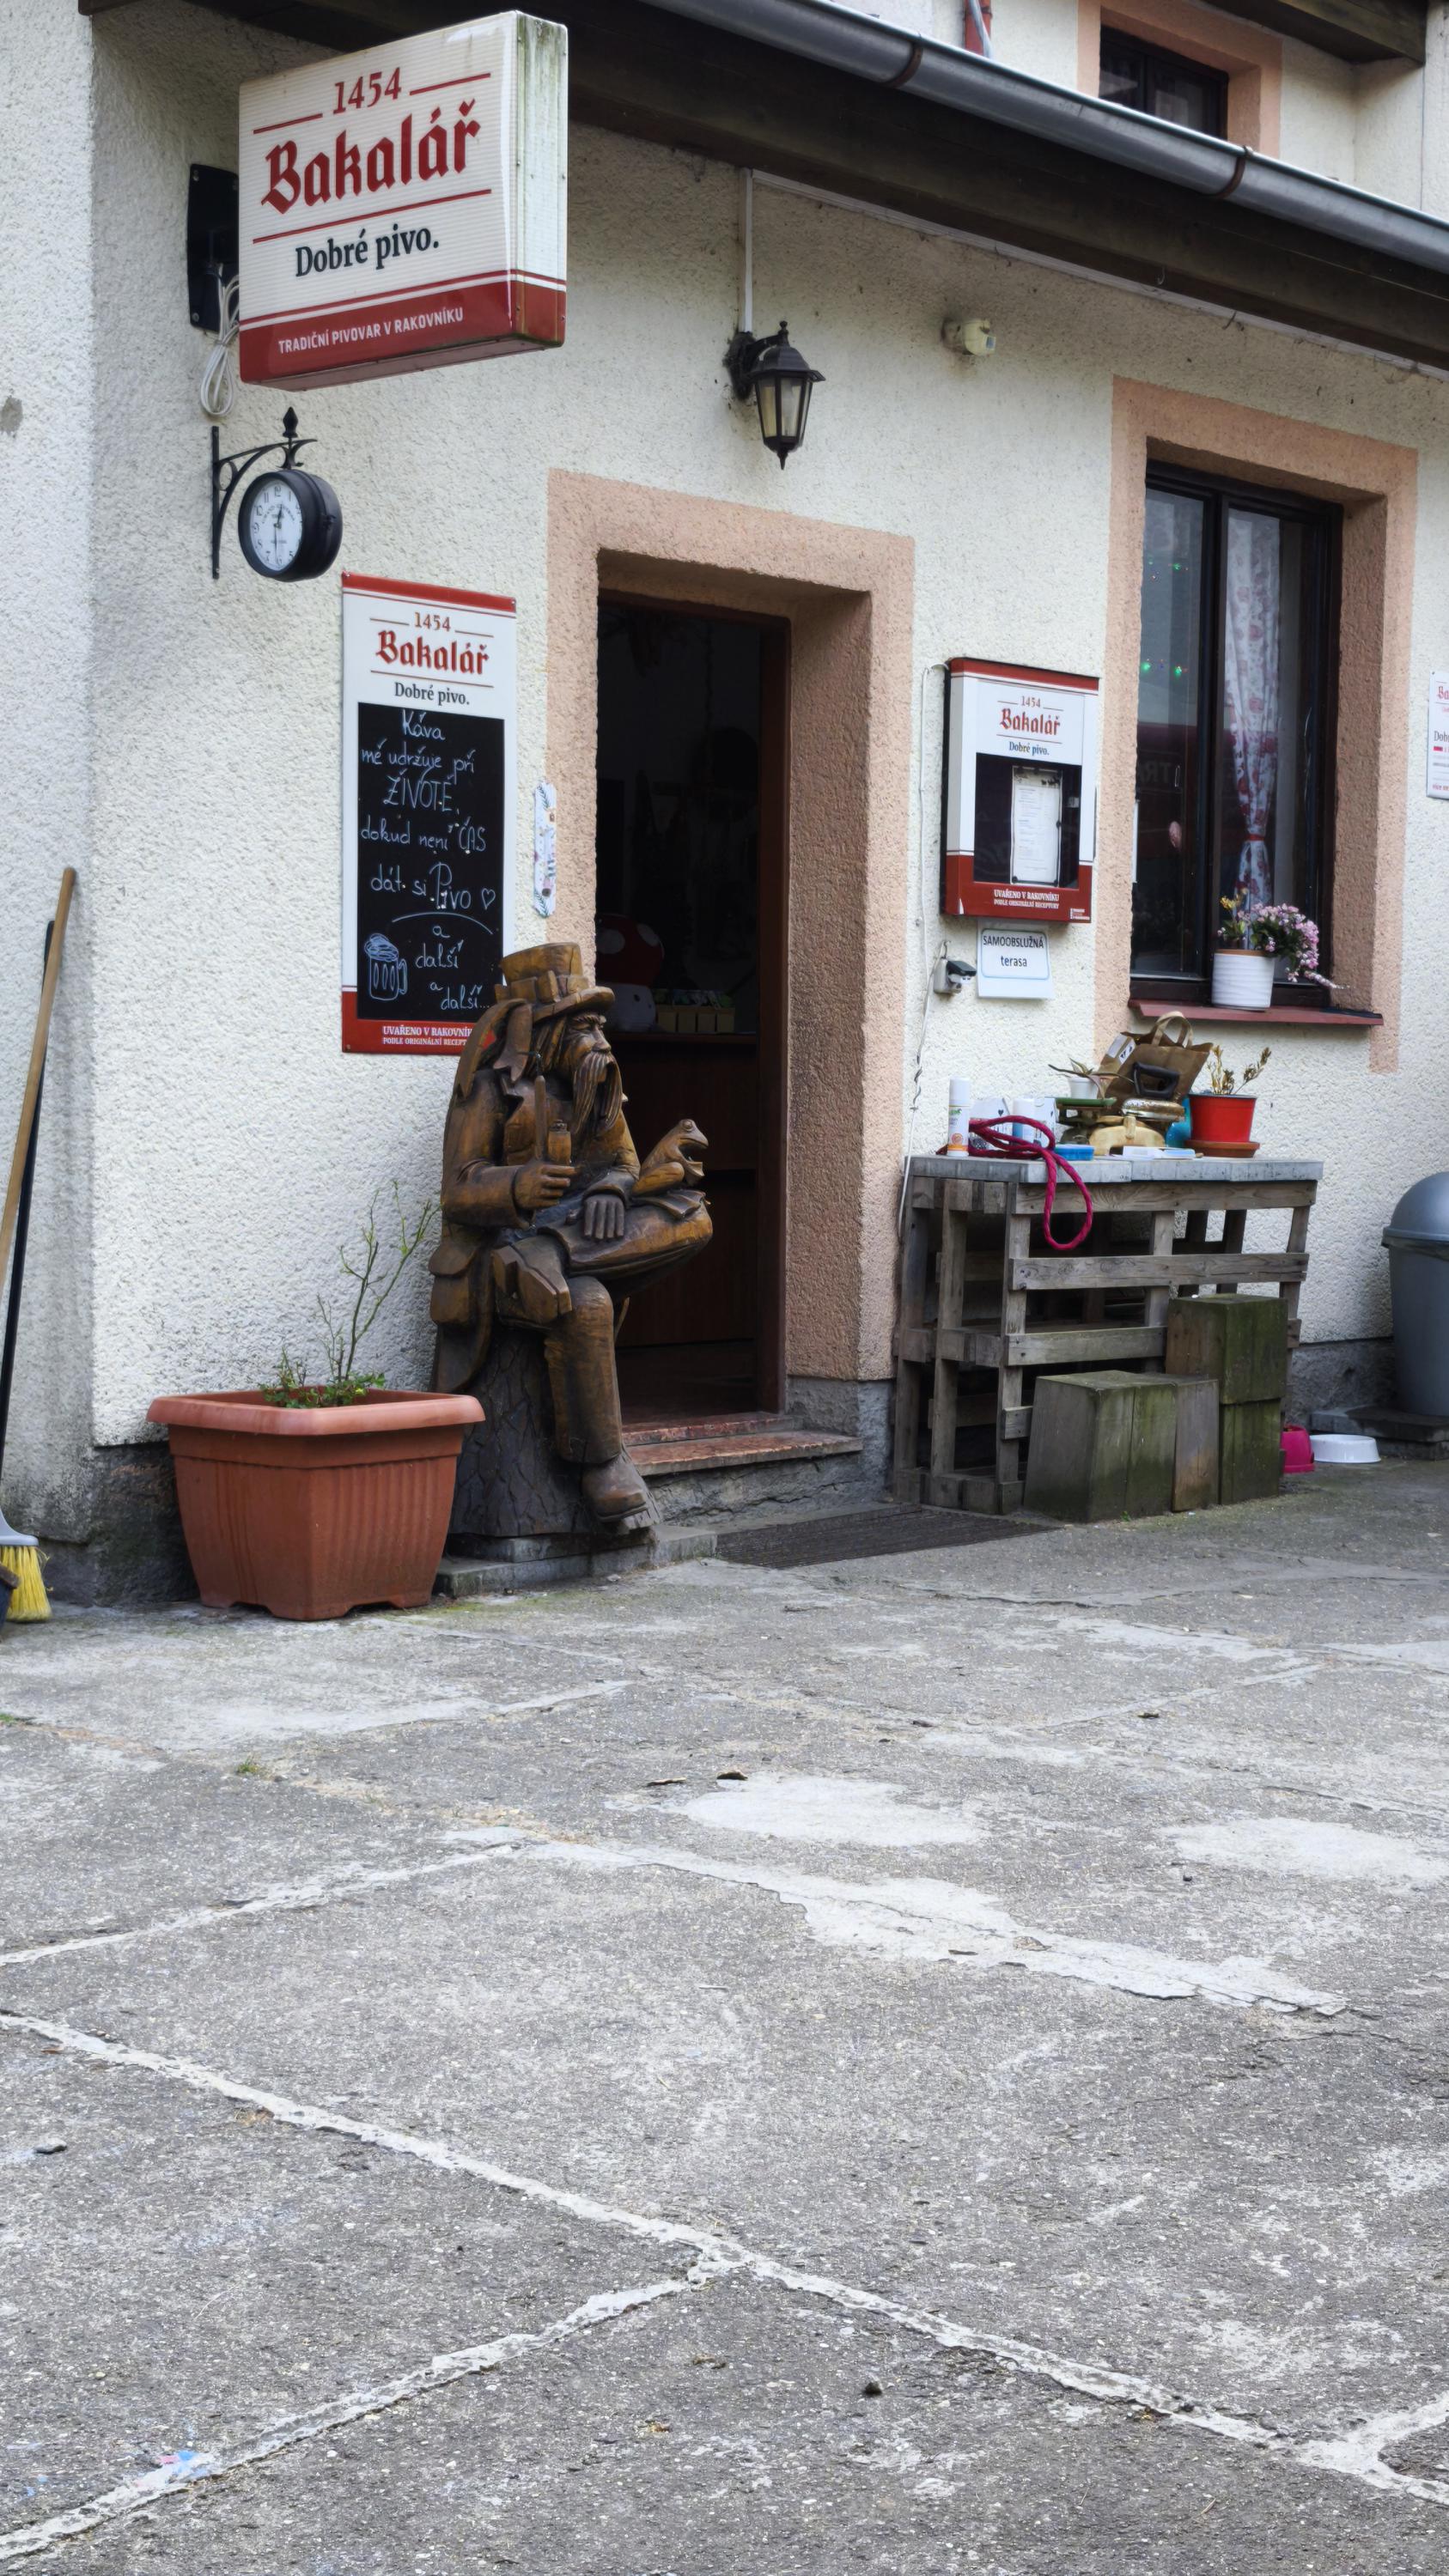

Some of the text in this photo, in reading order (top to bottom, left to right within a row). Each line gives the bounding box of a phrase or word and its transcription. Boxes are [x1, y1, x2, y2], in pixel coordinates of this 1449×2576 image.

[332, 67, 402, 114] 1454
[261, 98, 481, 215] Bakalář
[295, 223, 439, 277] Dobré pivo.
[278, 306, 464, 354] TRADIČNÍ PIVOVAR V RAKOVNÍKU
[414, 611, 451, 632] 1454
[375, 630, 490, 675] Bakalář
[394, 682, 470, 707] Dobré pivo.
[1020, 696, 1041, 708] 1454
[402, 709, 446, 740] Káva
[1000, 708, 1061, 736] Bakalář
[388, 741, 442, 784] udržuje
[1009, 741, 1050, 756] Dobré pivo.
[361, 814, 411, 845] dokud
[459, 817, 487, 852] ČAS
[370, 863, 402, 893] dát
[411, 880, 427, 896] si
[432, 926, 451, 939] a
[983, 935, 1044, 949] SAMOOBSLUŽNÁ
[415, 939, 464, 969] další
[1001, 955, 1027, 968] terasa
[429, 981, 443, 991] a
[382, 1024, 472, 1036] UVAŘENO V RAKOVNÍK
